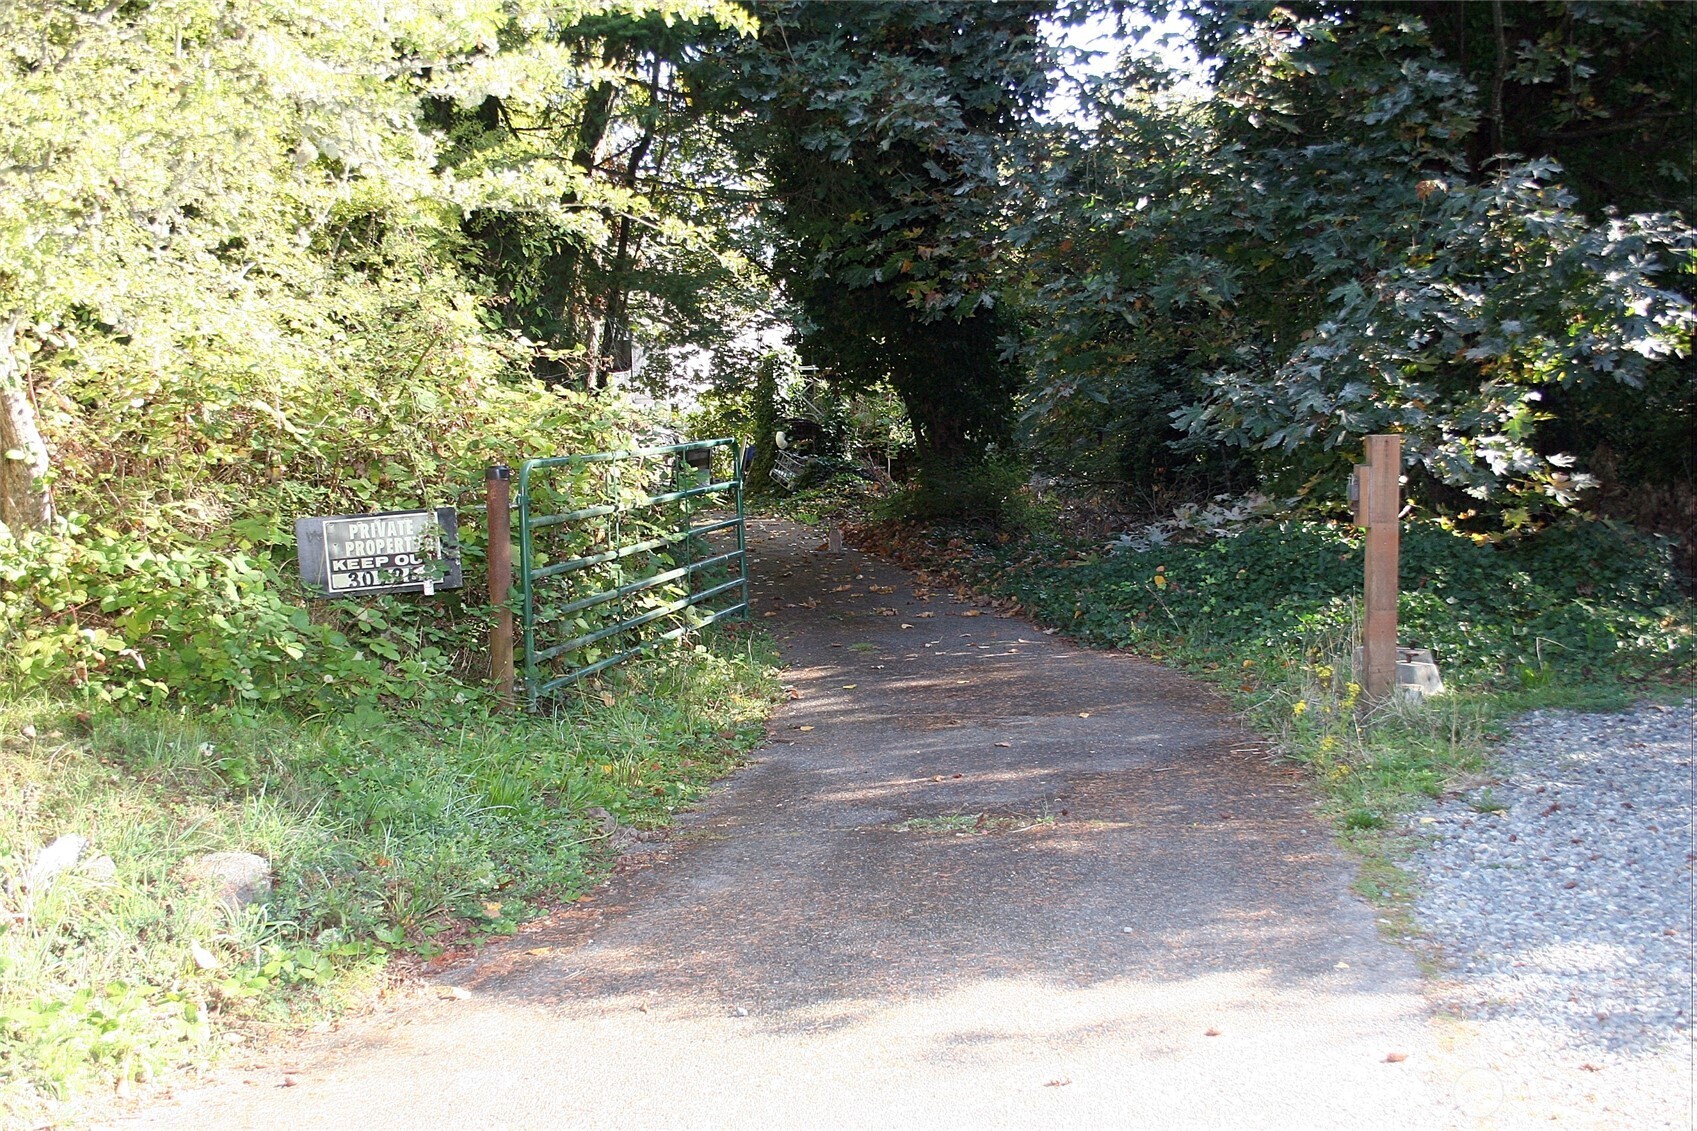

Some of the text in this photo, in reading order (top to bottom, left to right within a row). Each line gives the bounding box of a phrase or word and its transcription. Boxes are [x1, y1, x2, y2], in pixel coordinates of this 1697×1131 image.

[349, 520, 413, 539] PRIVATE
[333, 554, 425, 571] KEEP OU
